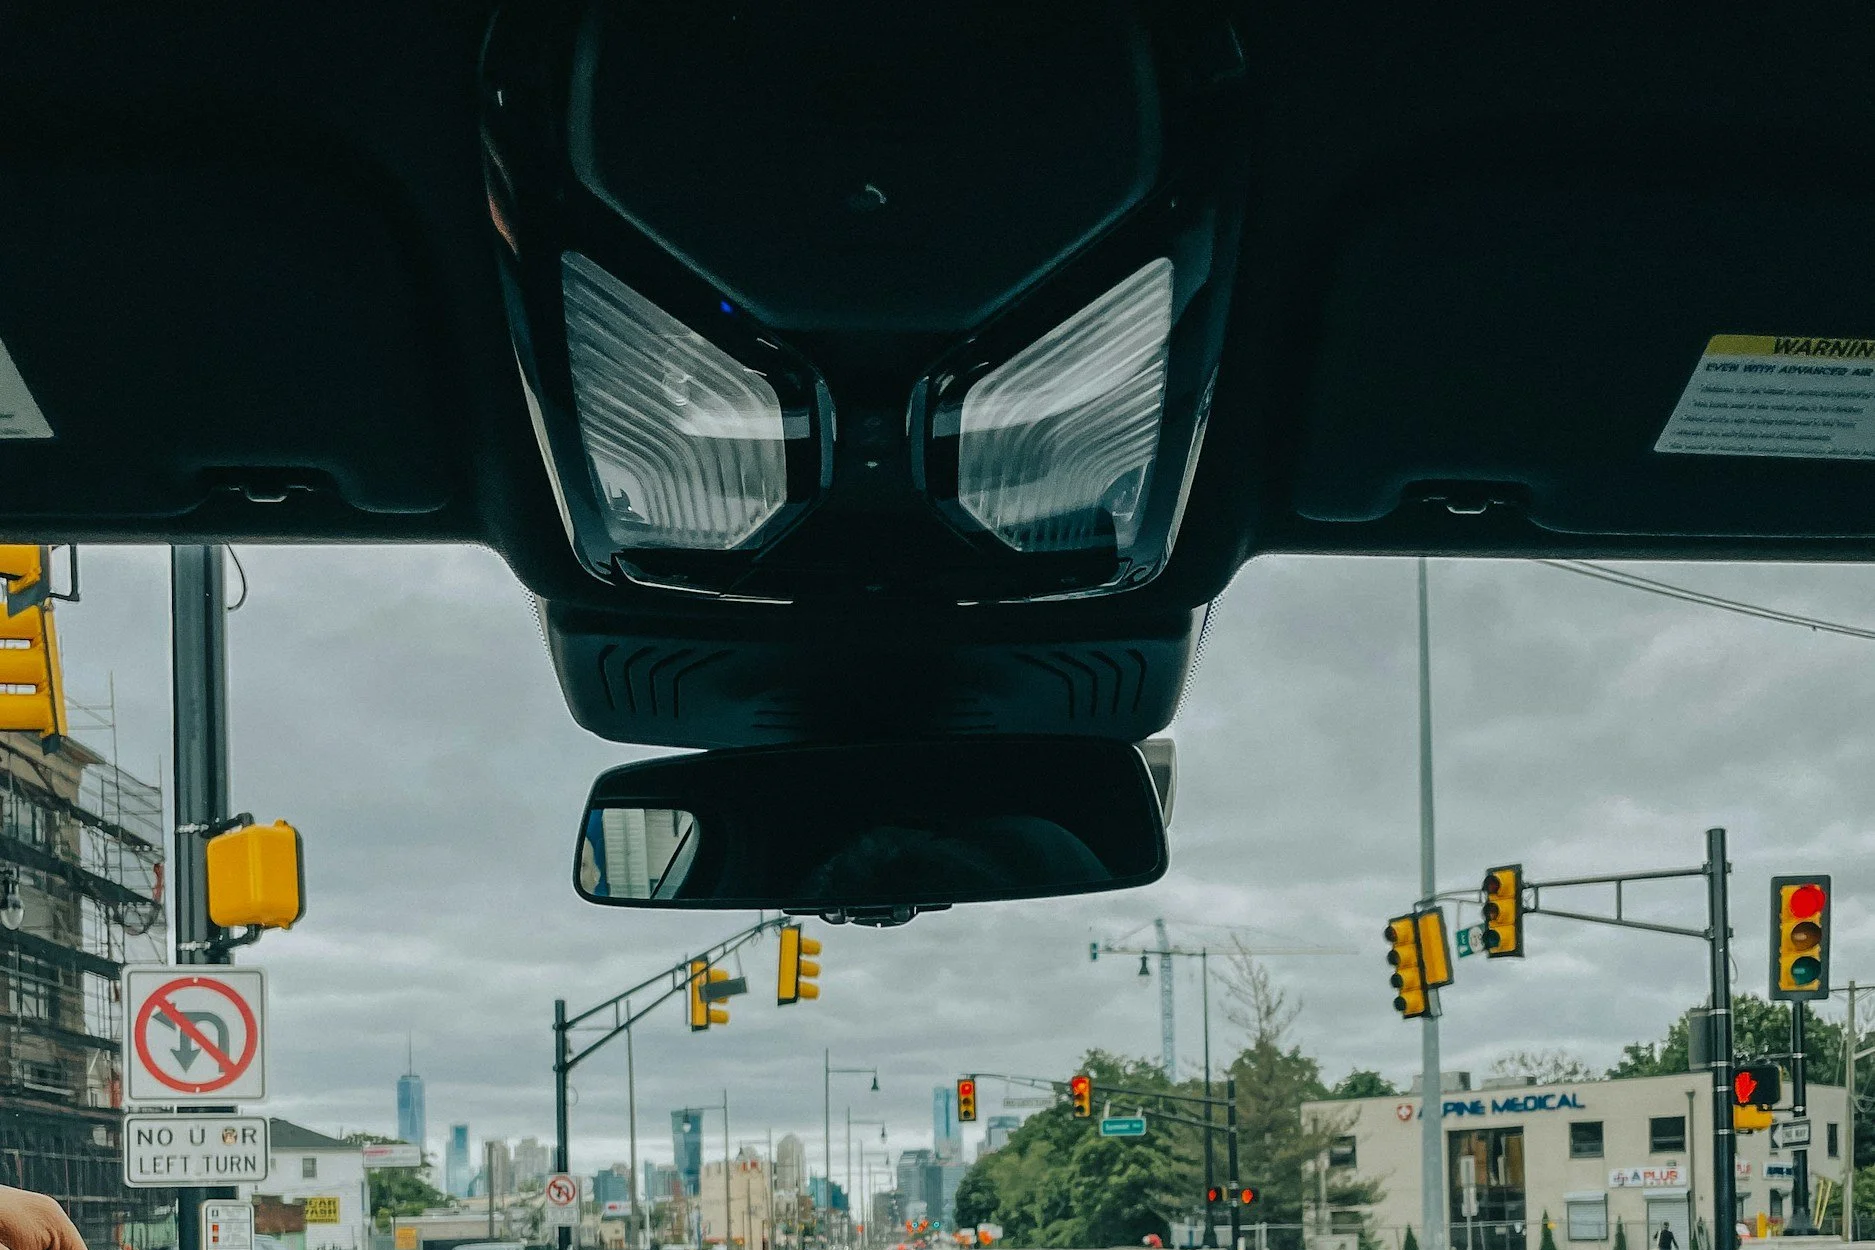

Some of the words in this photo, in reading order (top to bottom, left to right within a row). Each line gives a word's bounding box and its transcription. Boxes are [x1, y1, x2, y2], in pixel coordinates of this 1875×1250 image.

[1492, 1092, 1586, 1114] MEDICAL
[136, 1127, 174, 1146] NO
[189, 1127, 206, 1146] U
[138, 1154, 191, 1175] LEFT
[202, 1154, 257, 1174] TURN
[1631, 1169, 1642, 1182] A
[1643, 1169, 1679, 1182] PLUS
